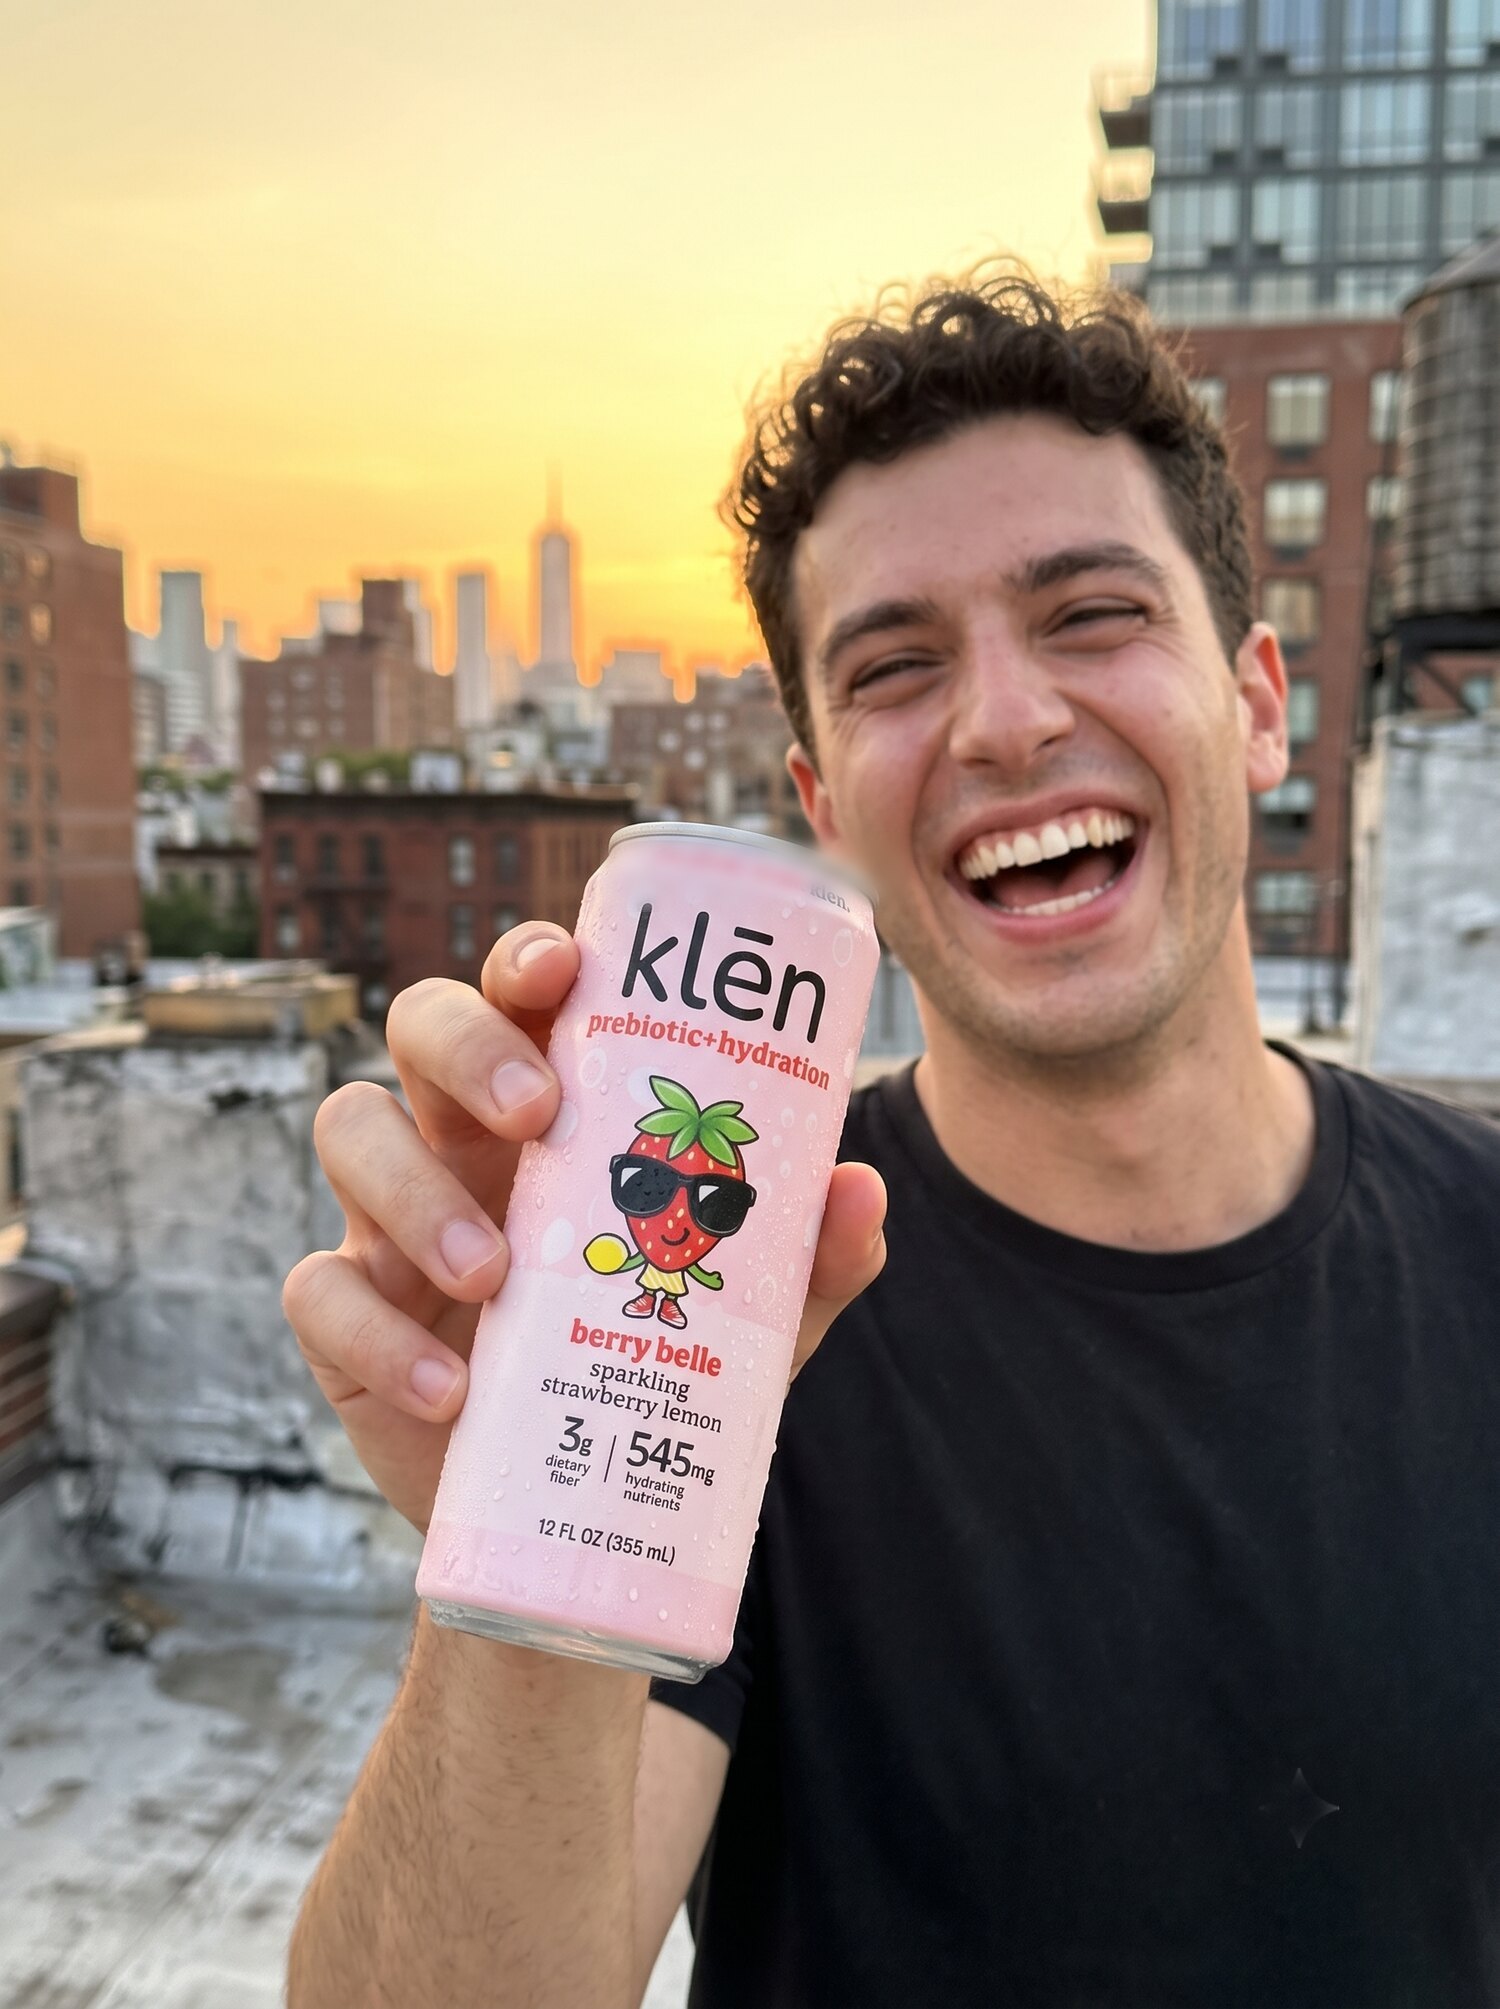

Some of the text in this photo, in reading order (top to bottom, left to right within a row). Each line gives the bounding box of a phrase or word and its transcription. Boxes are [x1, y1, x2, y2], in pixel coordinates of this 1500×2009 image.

[621, 902, 826, 1044] klēn
[586, 1012, 830, 1091] prebiotic+hydration
[570, 1318, 722, 1377] berry belle
[590, 1363, 690, 1402] sparkling
[541, 1377, 722, 1433] strawberry lemon
[558, 1415, 593, 1456] 3g
[545, 1455, 591, 1476] dietary
[549, 1470, 580, 1487] fiber
[626, 1430, 715, 1486] 545mg
[623, 1488, 681, 1511] nutrients
[625, 1472, 685, 1499] hydrating
[538, 1518, 676, 1566] 12 FL OZ (355 mL)
